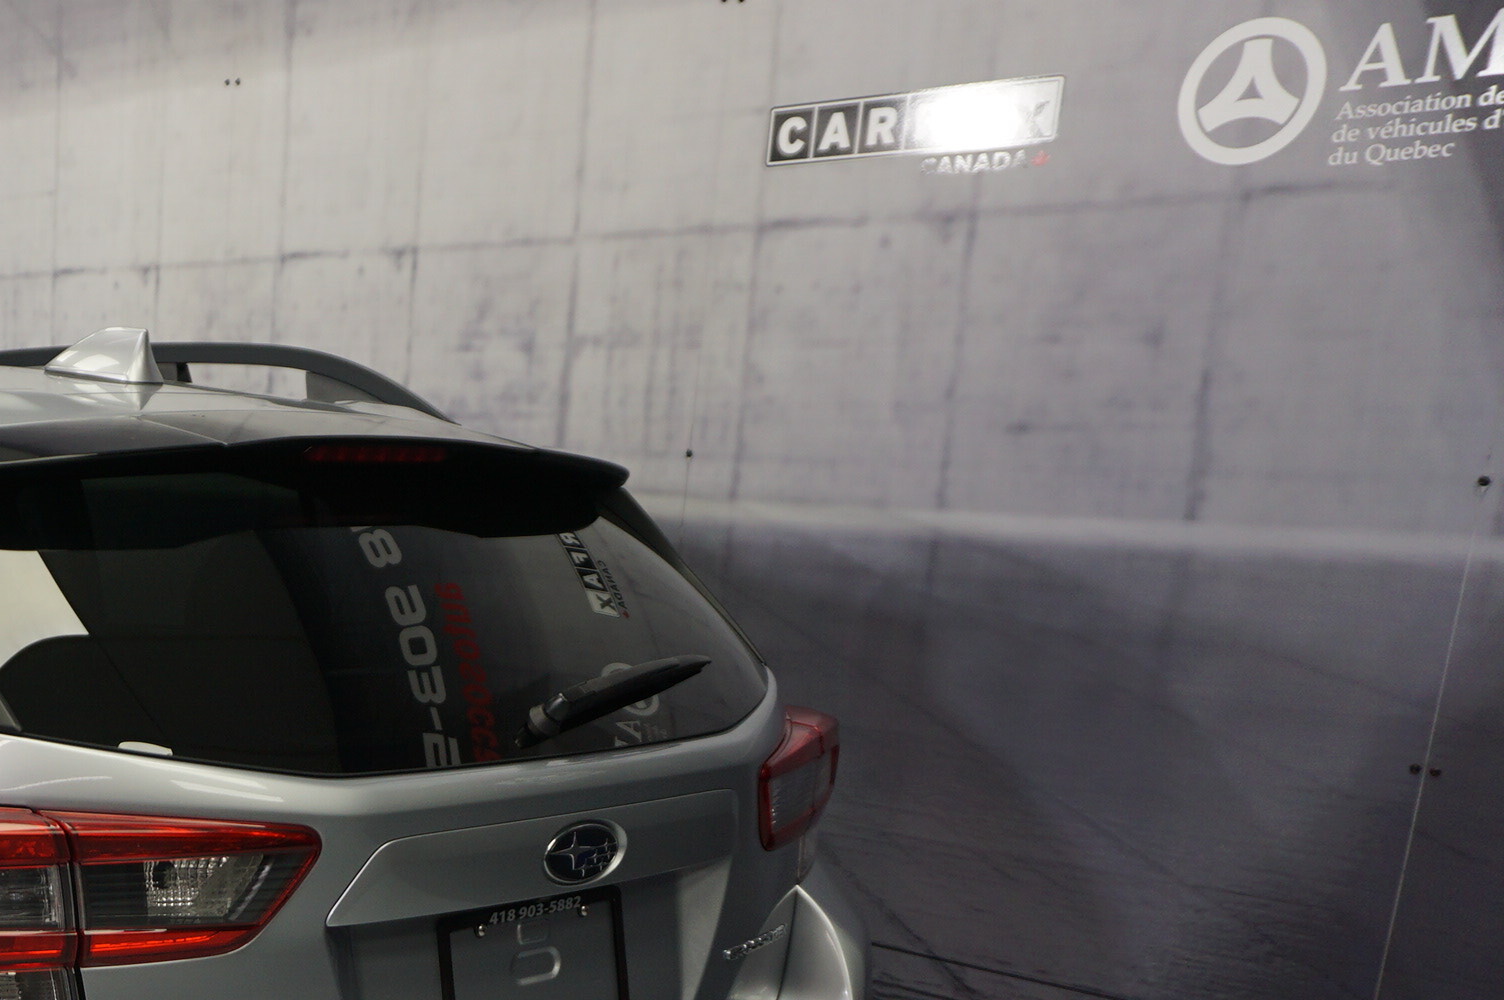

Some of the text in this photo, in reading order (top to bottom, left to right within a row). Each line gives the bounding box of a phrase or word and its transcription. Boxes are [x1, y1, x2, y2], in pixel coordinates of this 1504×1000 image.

[1336, 92, 1471, 120] Association
[1331, 125, 1360, 143] de
[1367, 114, 1477, 140] véhicules
[921, 150, 1028, 174] CANADA
[1328, 140, 1455, 166] du Quebec
[489, 896, 581, 925] 418 903-5882
